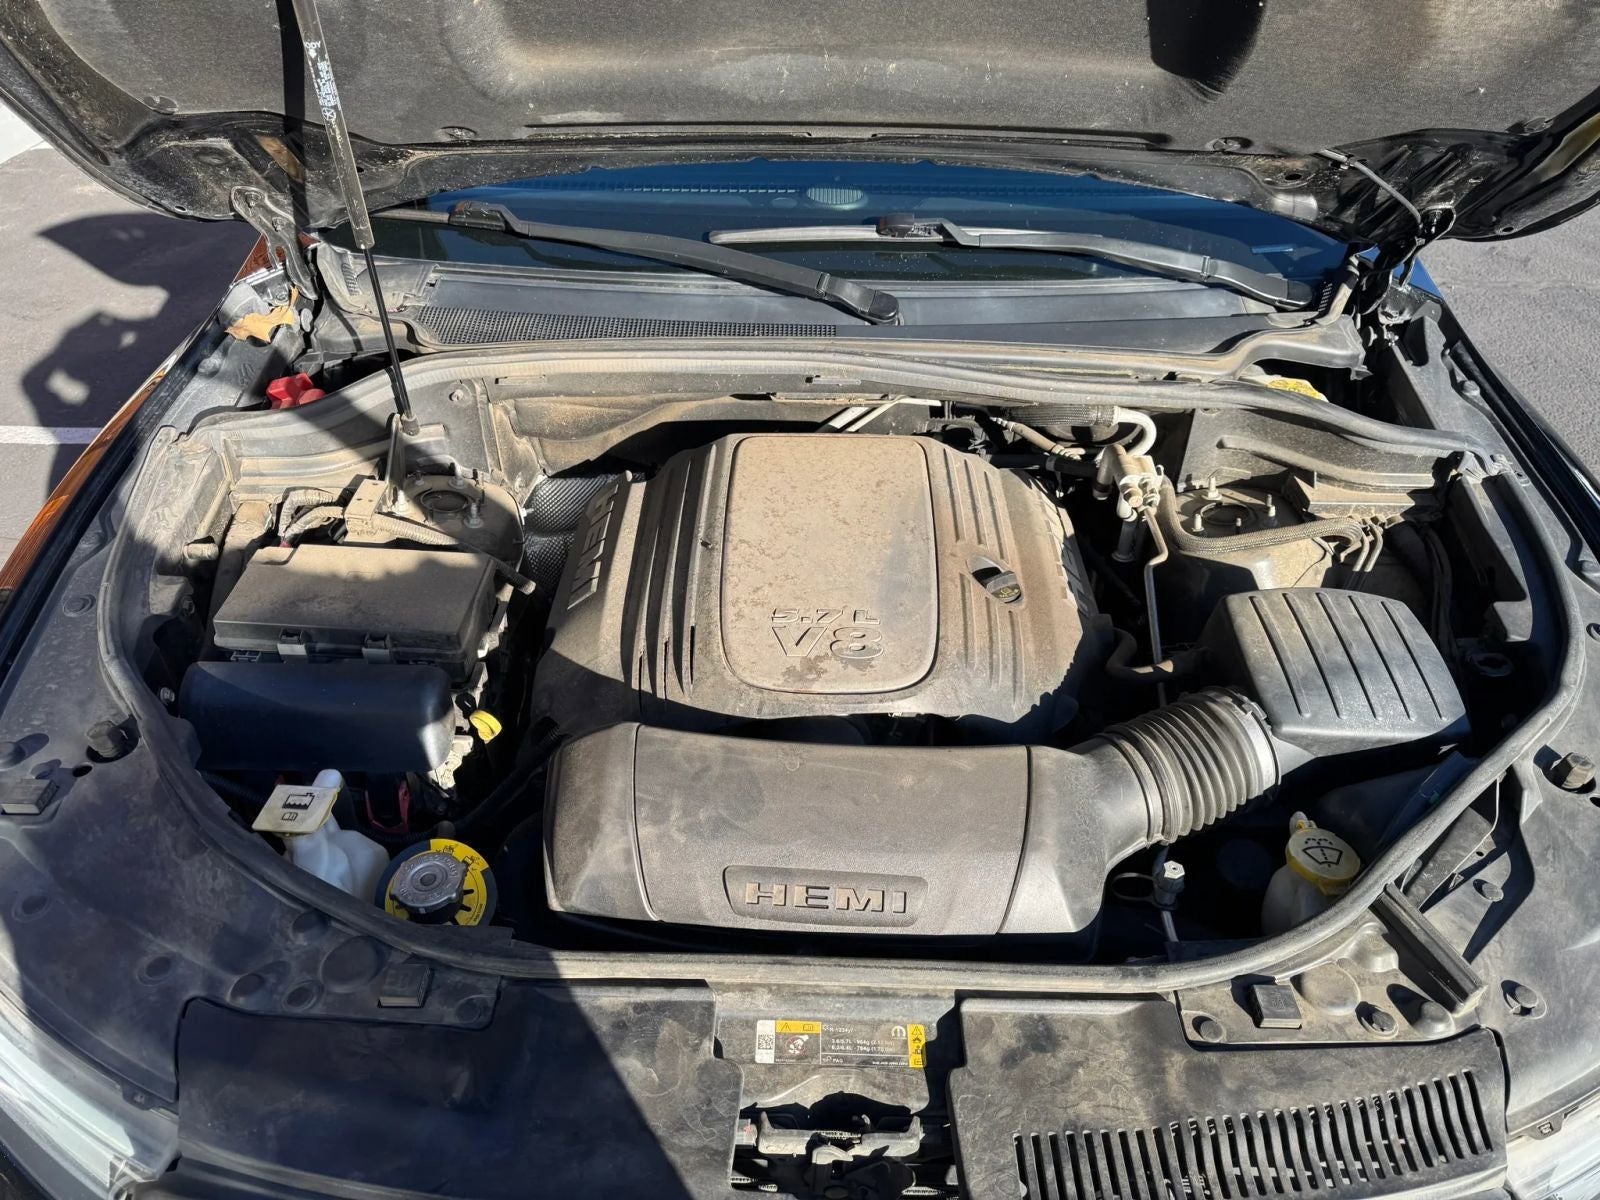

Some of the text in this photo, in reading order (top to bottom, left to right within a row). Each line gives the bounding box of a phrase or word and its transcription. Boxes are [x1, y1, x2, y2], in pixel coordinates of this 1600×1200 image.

[304, 40, 321, 49] ODY
[567, 483, 619, 609] HEMI
[772, 626, 884, 659] V8
[745, 882, 907, 913] HEMI
